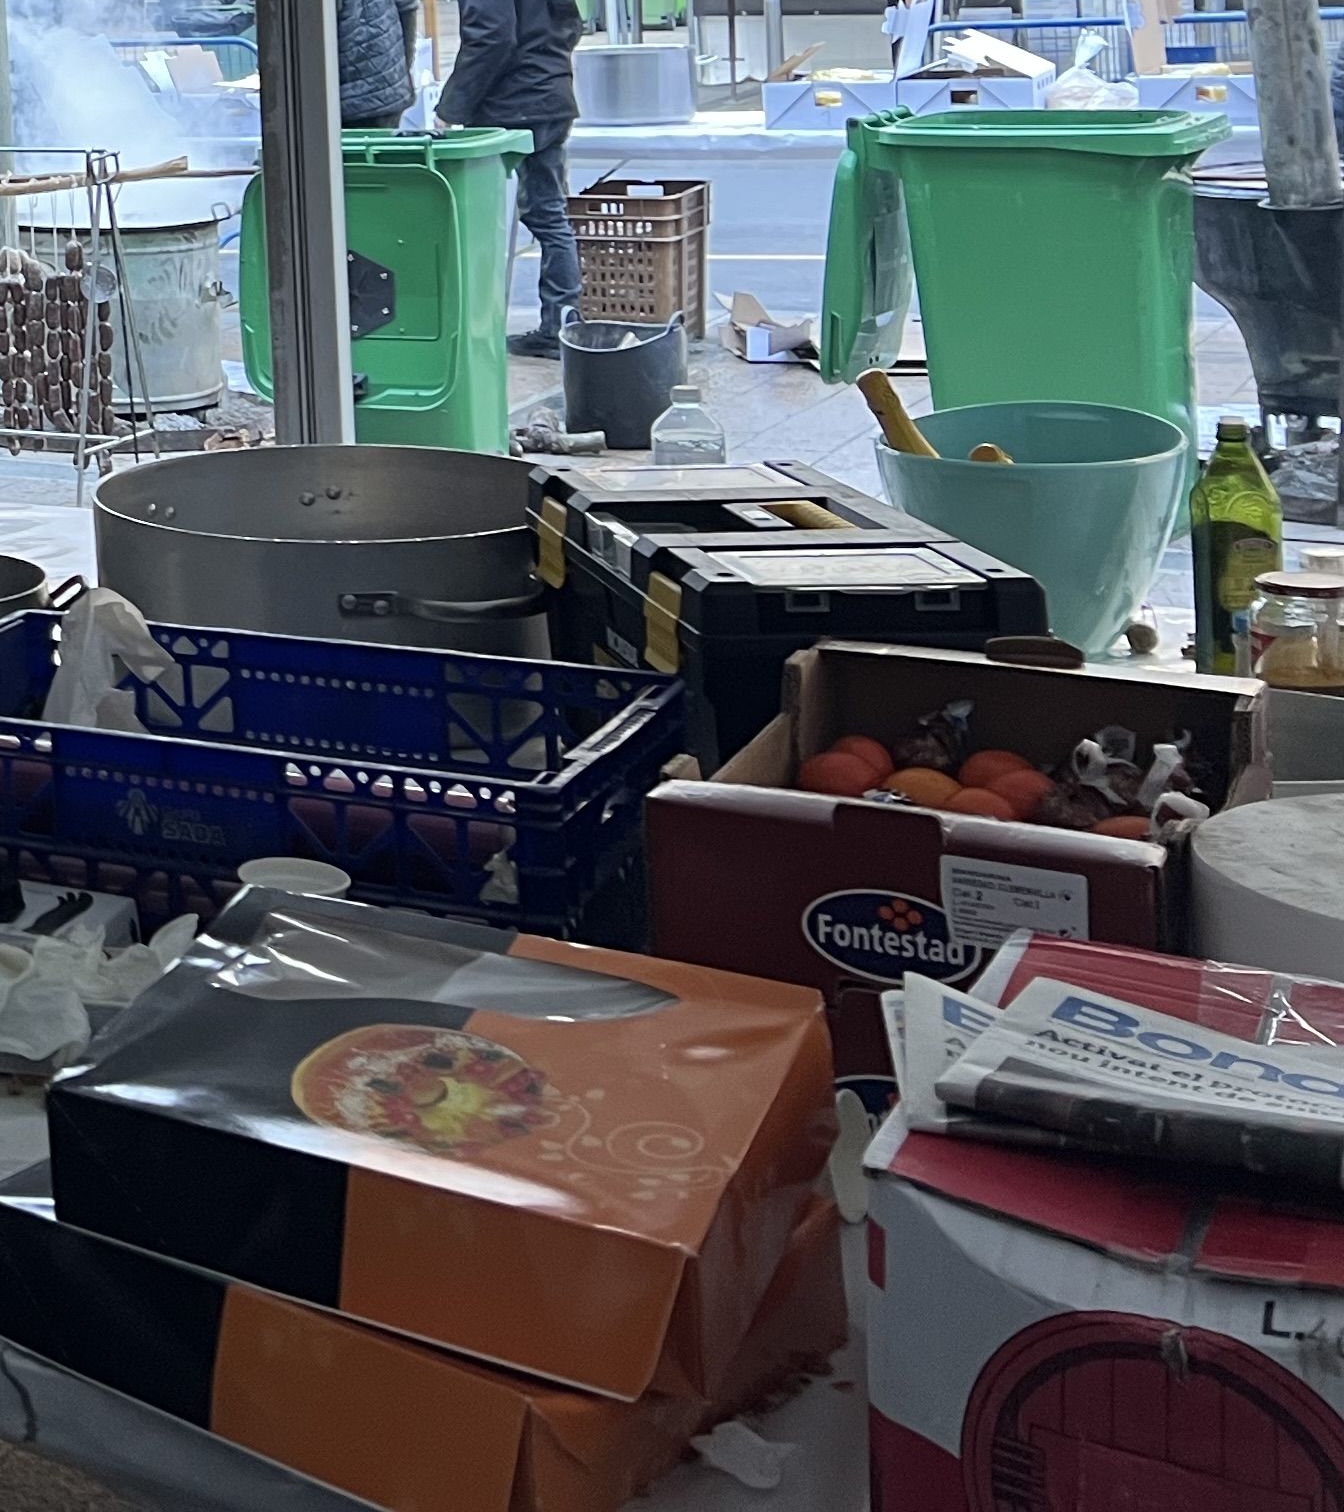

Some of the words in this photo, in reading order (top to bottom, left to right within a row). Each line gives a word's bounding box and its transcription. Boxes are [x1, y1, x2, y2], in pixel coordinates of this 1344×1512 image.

[817, 913, 966, 966] Fontestad
[1024, 1039, 1090, 1063] nou
[1098, 1059, 1206, 1092] intent
[1034, 1029, 1160, 1071] Activat
